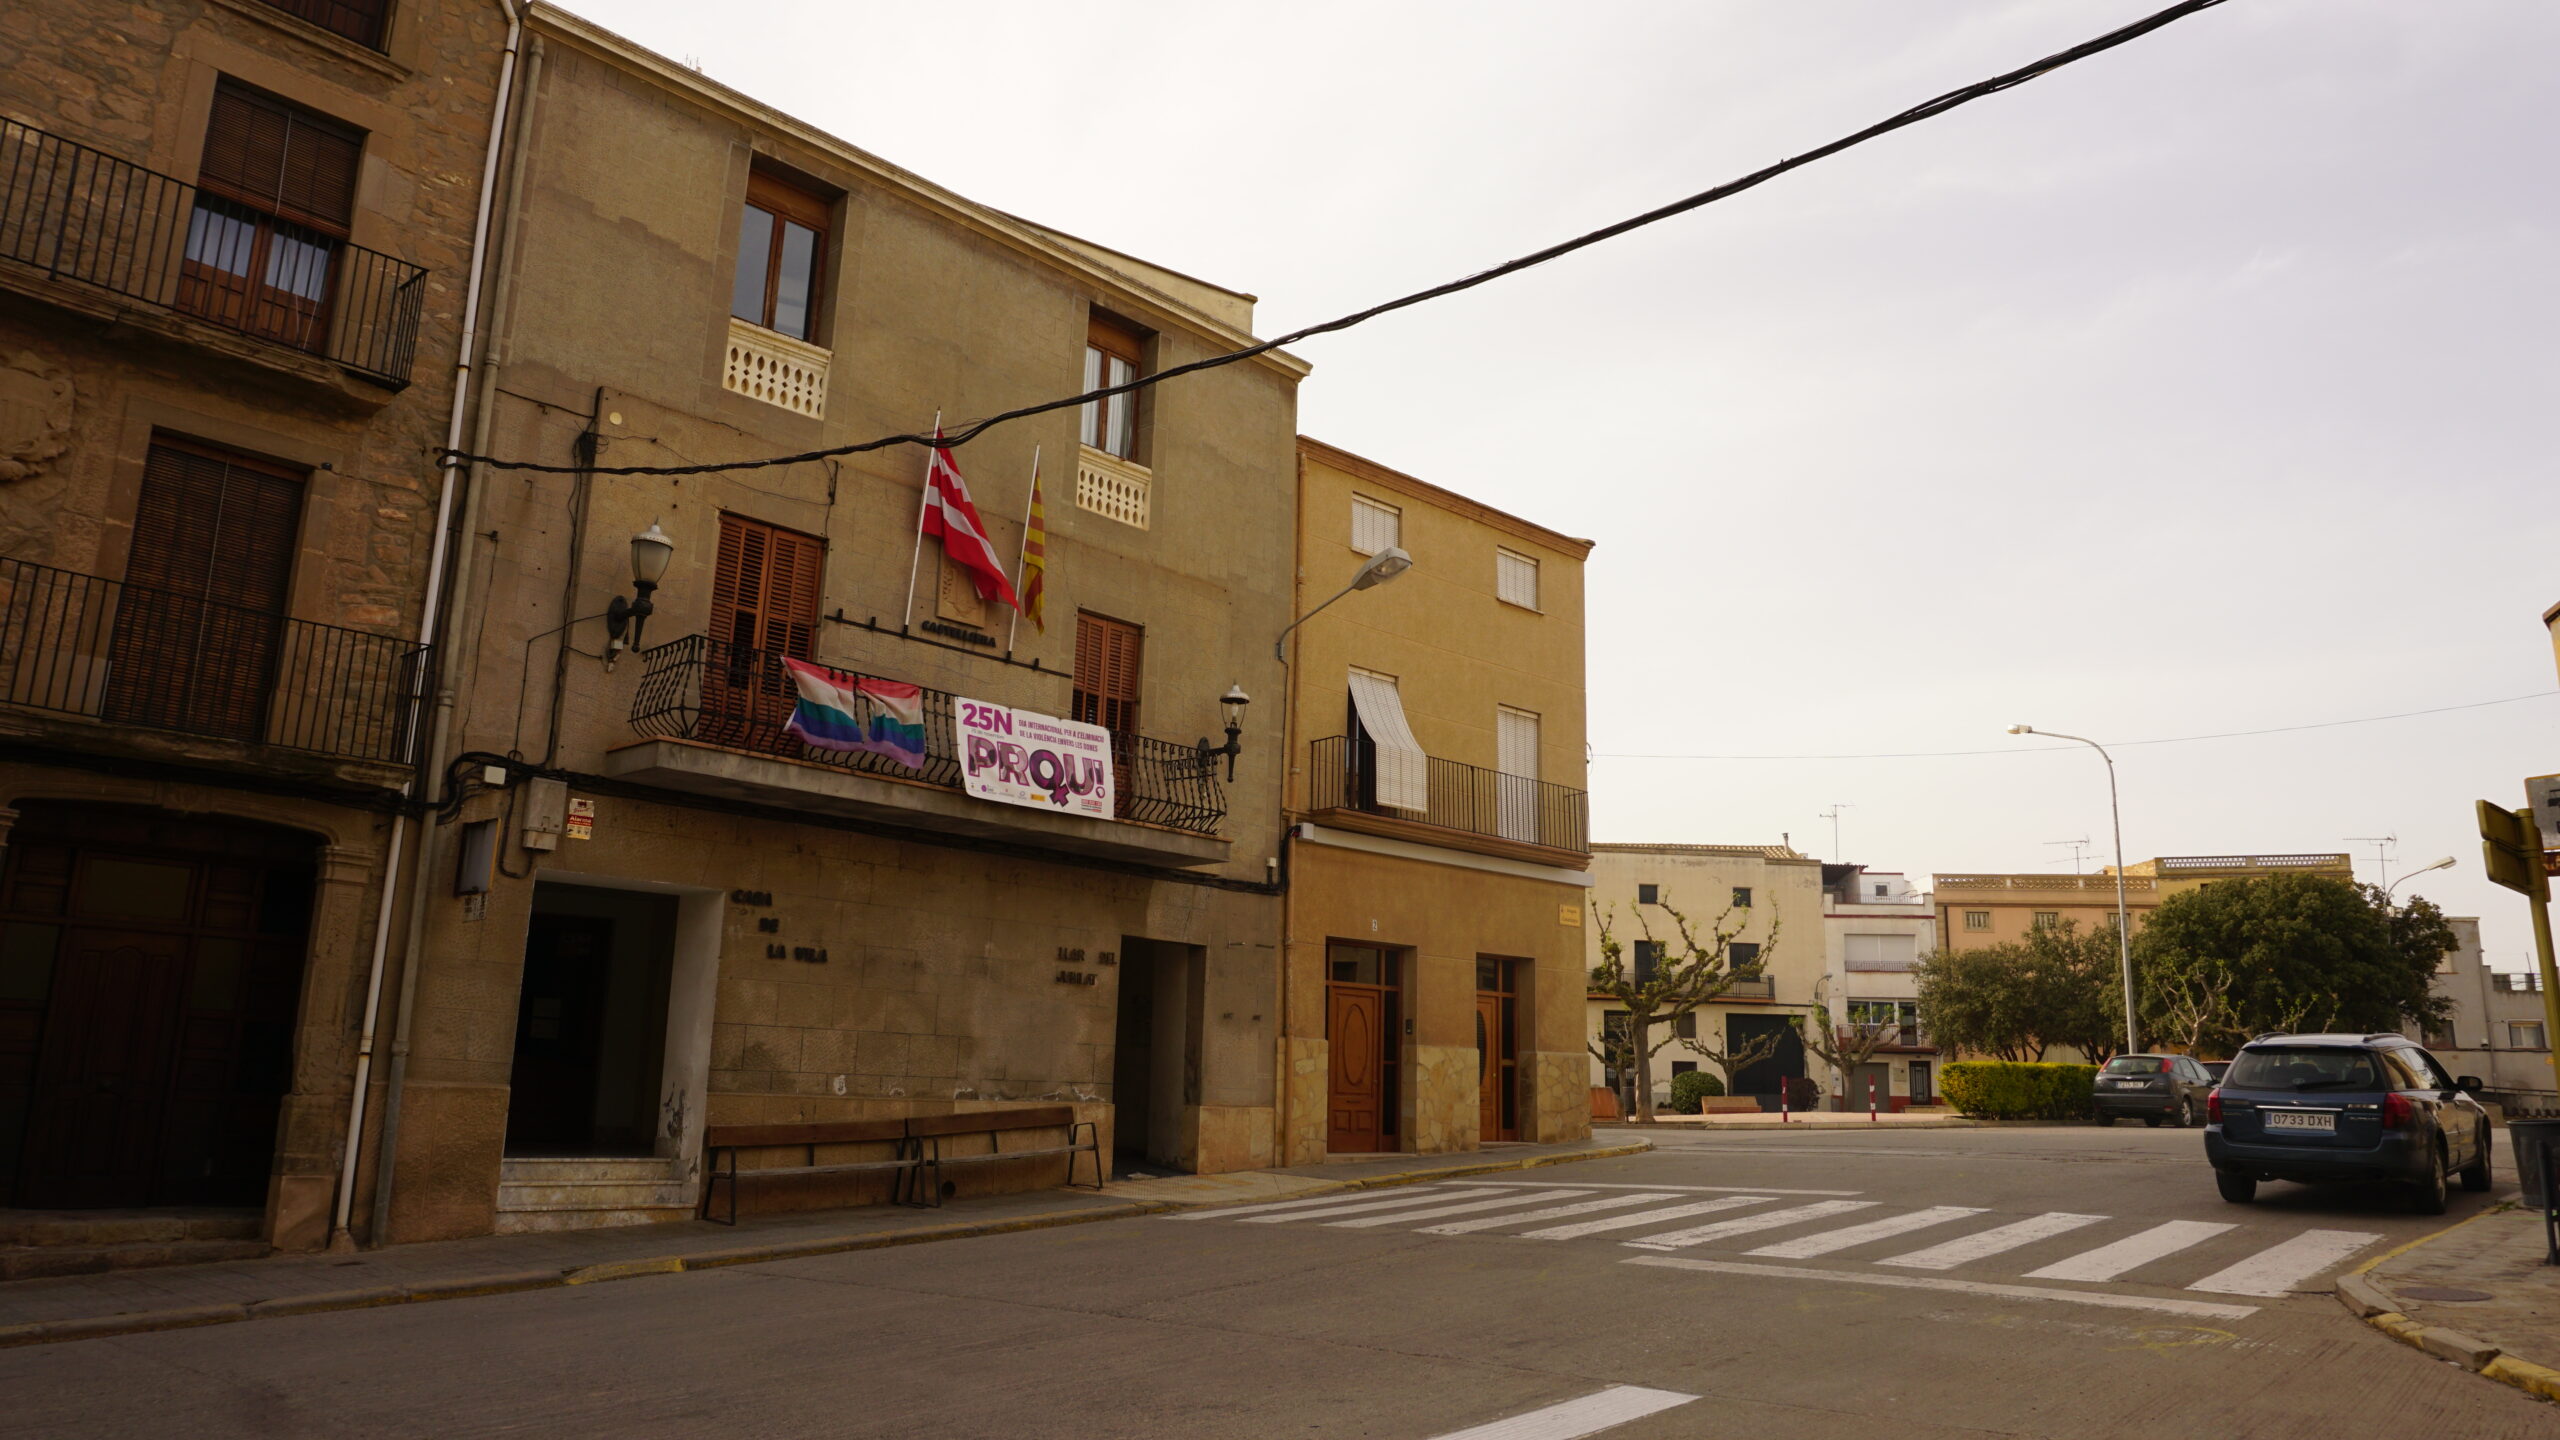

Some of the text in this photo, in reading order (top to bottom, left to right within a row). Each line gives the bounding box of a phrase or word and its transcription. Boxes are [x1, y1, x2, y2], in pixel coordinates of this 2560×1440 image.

[961, 703, 1013, 736] 25N
[1018, 719, 1027, 727] DIA
[1028, 721, 1063, 735] INTERNACIONAL
[1083, 743, 1098, 752] DONES
[767, 943, 786, 959] LA
[1098, 952, 1118, 966] DEL
[2273, 1114, 2332, 1127] 0733 DXH
